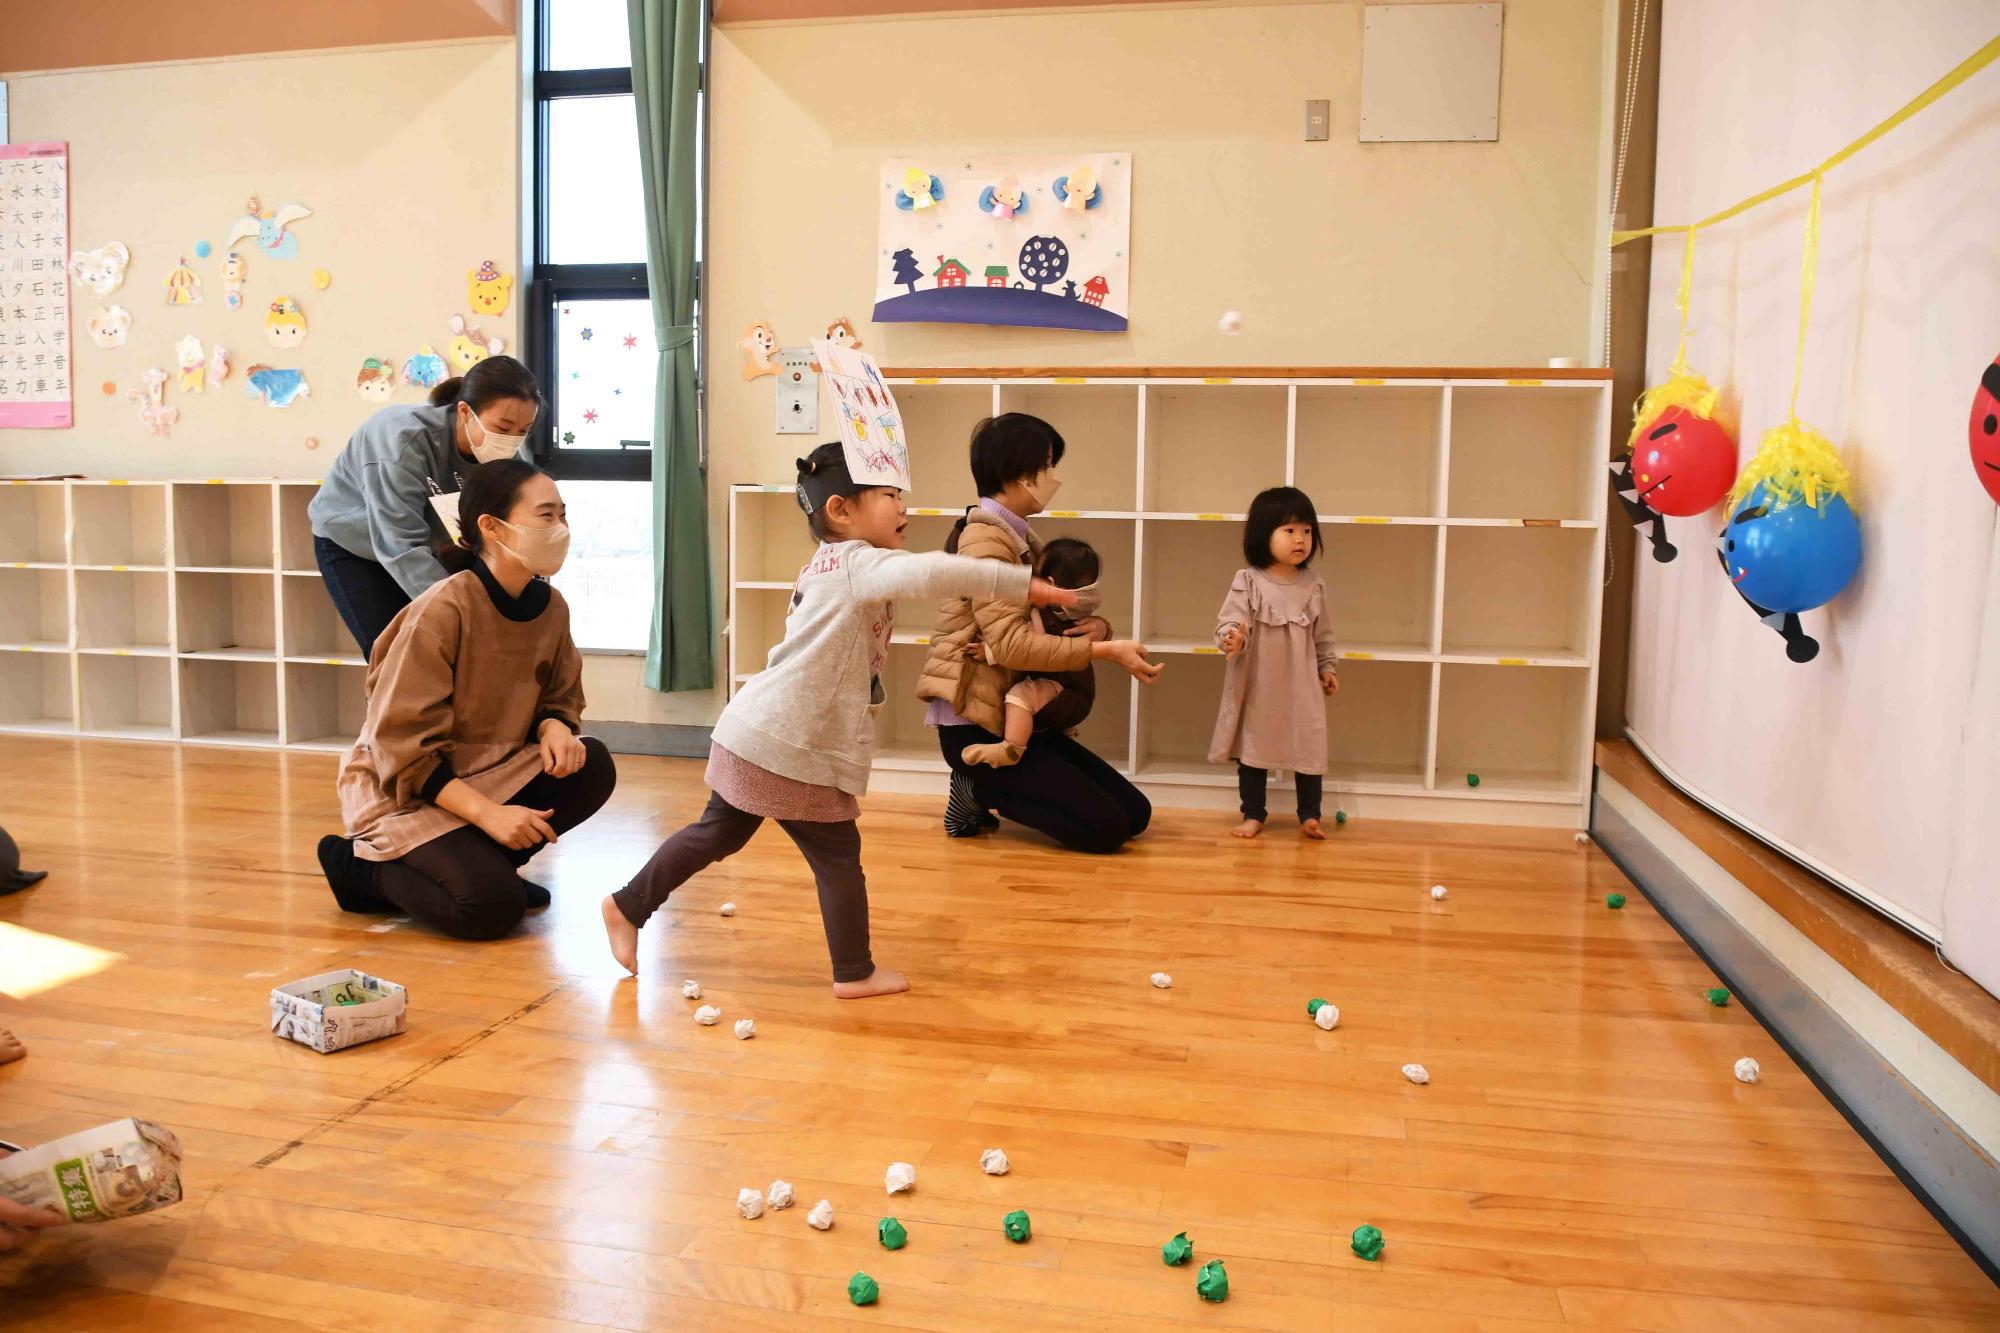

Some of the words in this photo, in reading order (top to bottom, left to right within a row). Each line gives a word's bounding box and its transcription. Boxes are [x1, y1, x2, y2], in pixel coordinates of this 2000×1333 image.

[11, 160, 24, 174] 六
[31, 160, 43, 174] 七
[49, 160, 63, 171] 八
[12, 185, 25, 200] 水
[31, 184, 45, 199] 木
[51, 184, 63, 198] 金
[12, 209, 25, 225] 大
[50, 207, 64, 222] 小
[12, 234, 25, 248] 人
[32, 233, 44, 248] 子
[51, 232, 64, 247] 女
[12, 257, 24, 272] 川
[32, 258, 43, 271] 田
[51, 256, 64, 272] 林
[13, 281, 24, 297] 夕
[32, 282, 44, 296] 石
[52, 281, 64, 296] 花
[13, 305, 26, 321] 本
[34, 306, 46, 320] 正
[54, 305, 64, 321] 円
[15, 330, 26, 345] 出
[53, 329, 65, 345] 学
[15, 354, 27, 370] 先
[34, 354, 47, 370] 早
[53, 354, 66, 370] 音
[16, 379, 27, 394] 力
[35, 378, 48, 395] 車
[55, 378, 67, 395] 年
